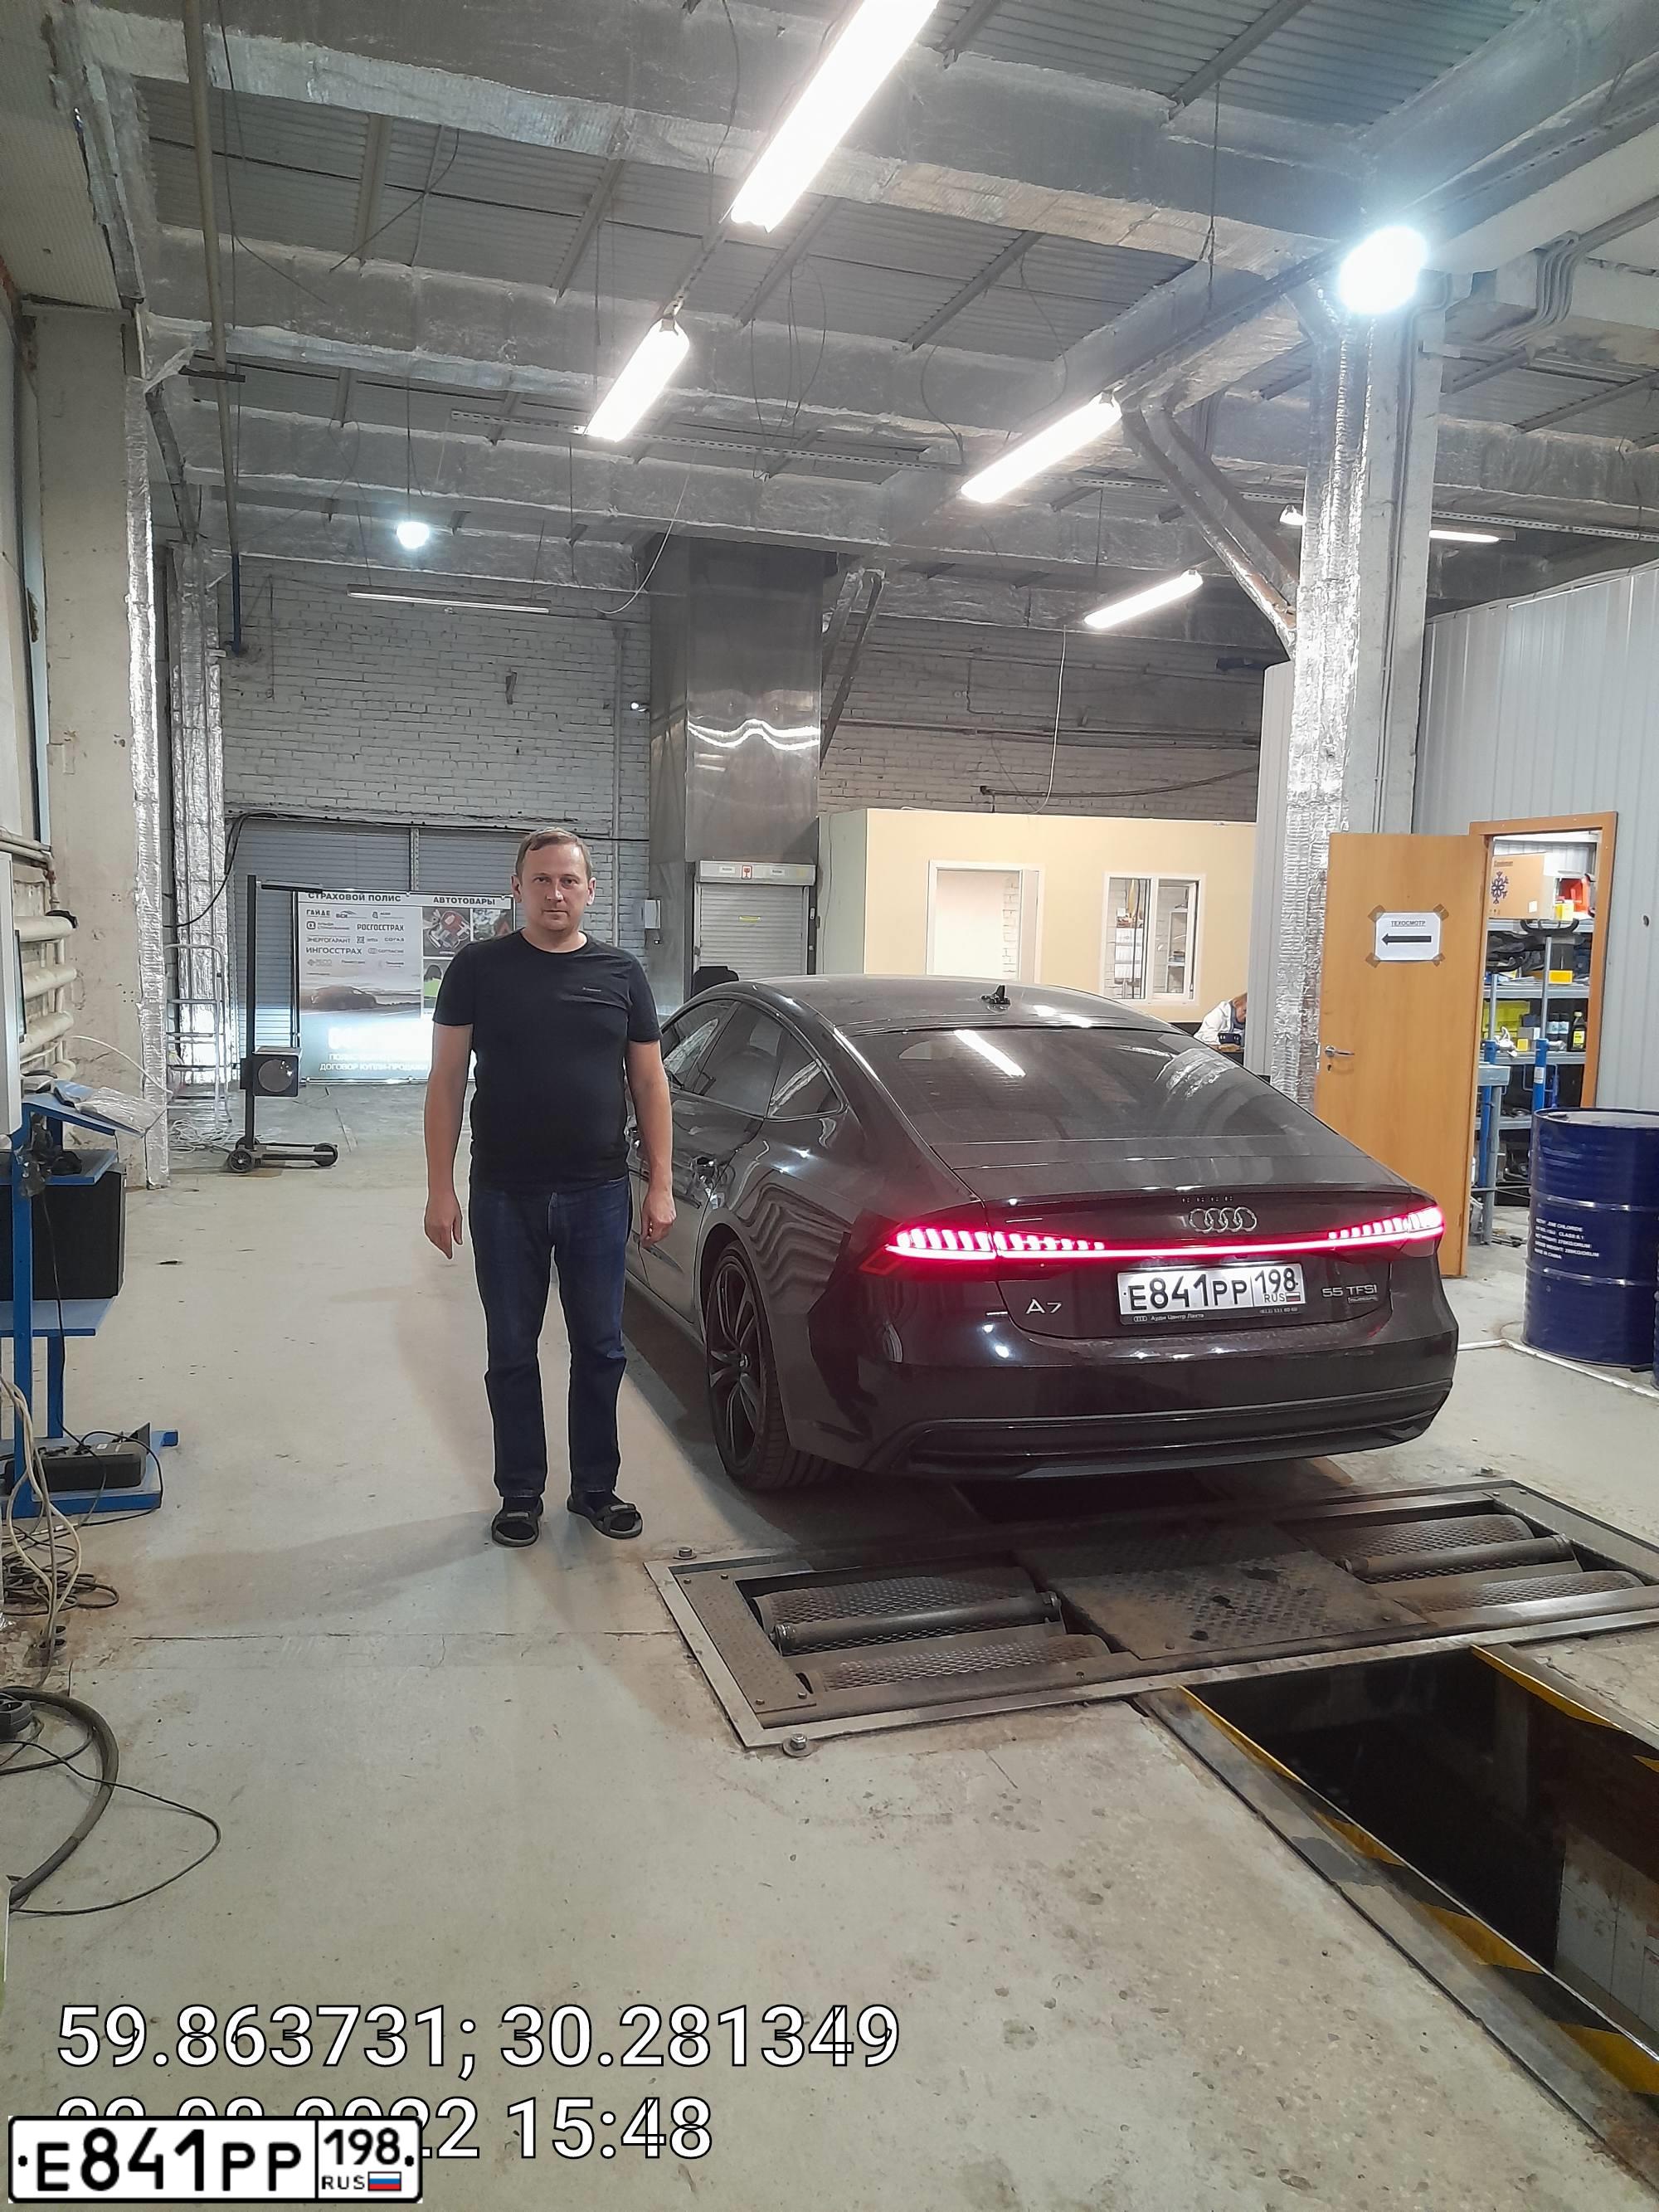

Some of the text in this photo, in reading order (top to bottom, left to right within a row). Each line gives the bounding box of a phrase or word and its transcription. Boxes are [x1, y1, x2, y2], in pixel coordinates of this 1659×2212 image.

[433, 896, 496, 905] АВТОТОВАРЫ
[305, 947, 362, 955] ИНГОССТРАХ
[319, 1063, 358, 1072] ДОГОВОР
[1128, 1267, 1295, 1311] Е841РР 198
[1321, 1284, 1378, 1298] 55 TFSI
[1264, 1293, 1286, 1303] RUS
[1025, 1298, 1062, 1314] A7
